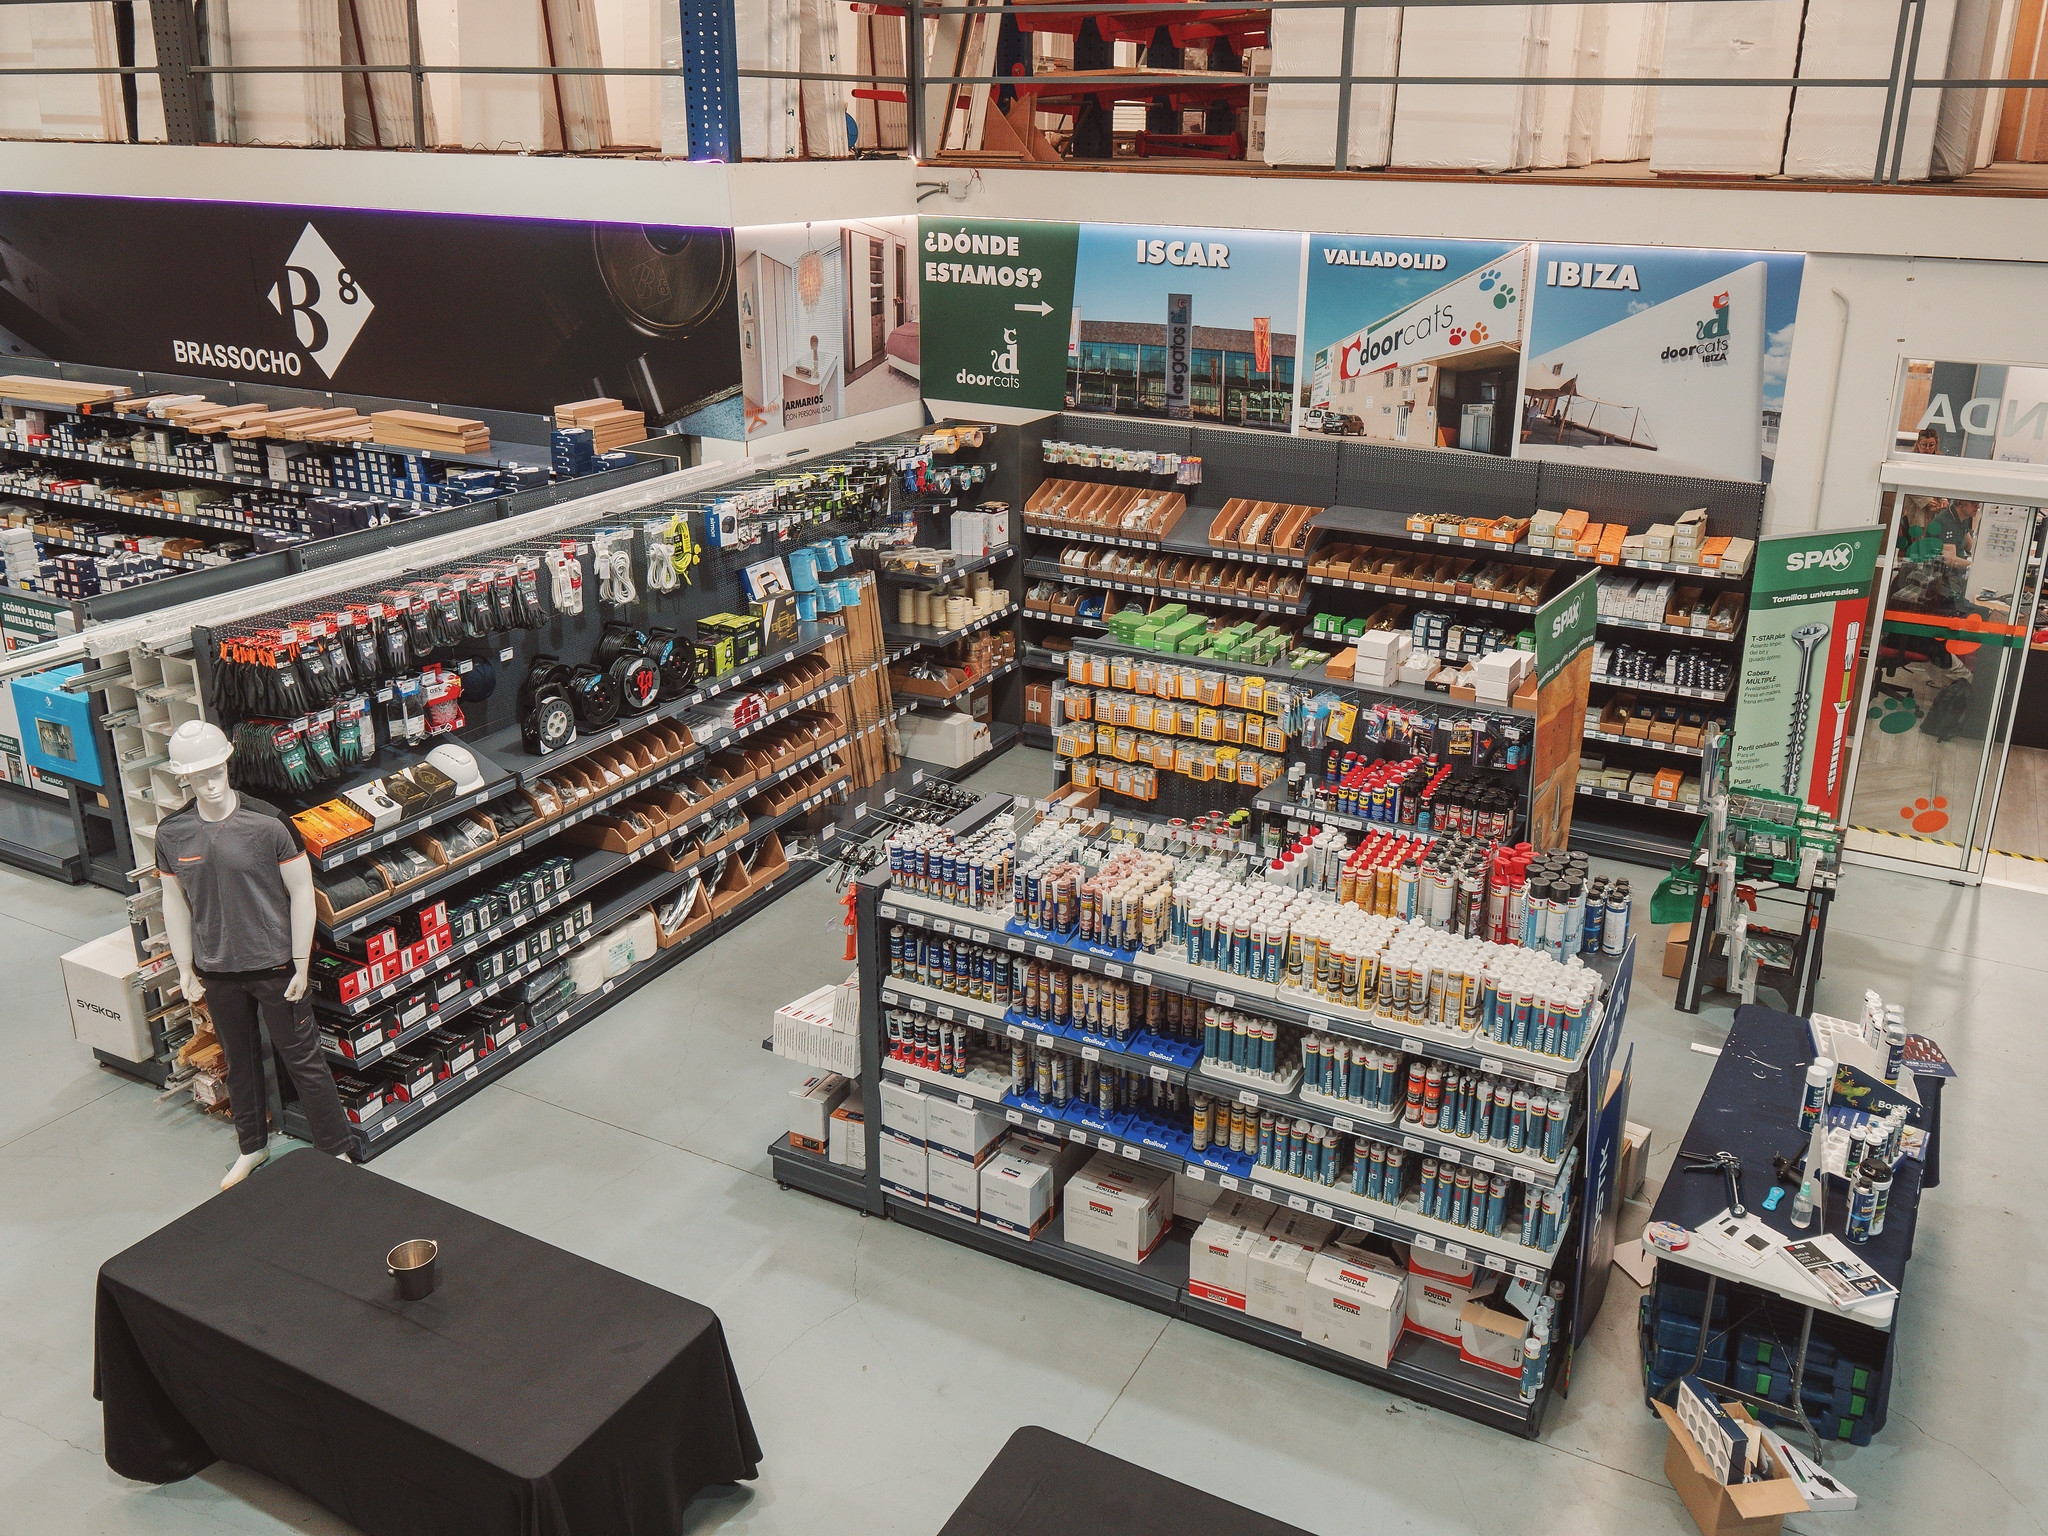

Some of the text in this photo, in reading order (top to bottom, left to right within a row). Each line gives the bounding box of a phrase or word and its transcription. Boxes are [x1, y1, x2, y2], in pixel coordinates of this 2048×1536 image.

[924, 227, 1020, 257] ¿DÓNDE
[1136, 239, 1230, 268] ISCAR
[1323, 248, 1448, 271] VALLADOLID
[925, 261, 1042, 289] ESTAMOS?
[1546, 261, 1640, 291] IBIZA
[1360, 304, 1454, 366] doorcats
[173, 339, 302, 377] BRASSOCHO
[1660, 338, 1729, 360] doorcats
[1702, 353, 1728, 363] IBIZA
[956, 368, 1020, 389] doorcats
[785, 394, 824, 411] ARMARIOS
[1786, 544, 1852, 572] SPAX
[1772, 588, 1859, 604] Tornillos universales
[2, 602, 52, 620] ¿CÓMO ELEGIR
[1552, 600, 1580, 639] SPAX
[4, 614, 56, 632] MUELLES CIERR
[1755, 741, 1780, 749] ondulado
[1025, 930, 1047, 940] Quilosa
[1089, 946, 1114, 957] Quilosa
[1251, 951, 1260, 979] Acryrub
[1266, 954, 1275, 983] Acryrub
[77, 999, 121, 1021] SYSKOR
[1021, 1020, 1045, 1031] Quilosa
[1082, 1036, 1106, 1047] Quilosa
[1148, 1051, 1173, 1062] Quilosa
[1021, 1102, 1044, 1114] Quilosa
[1081, 1119, 1105, 1130] Quilosa
[1479, 1115, 1490, 1141] Silirub
[1142, 1138, 1167, 1149] Quilosa
[1509, 1123, 1520, 1149] Silirub
[1204, 1159, 1229, 1171] Quilosa
[1096, 1185, 1120, 1196] SOUDAL
[1089, 1205, 1113, 1217] SOUDAL
[1451, 1199, 1460, 1224] Silirub
[1469, 1205, 1479, 1230] Silirub
[1209, 1249, 1229, 1259] SOUDAL
[1339, 1274, 1366, 1289] SOUDAL
[1424, 1290, 1451, 1304] SOUDAL
[1333, 1302, 1360, 1316] SOUDAL
